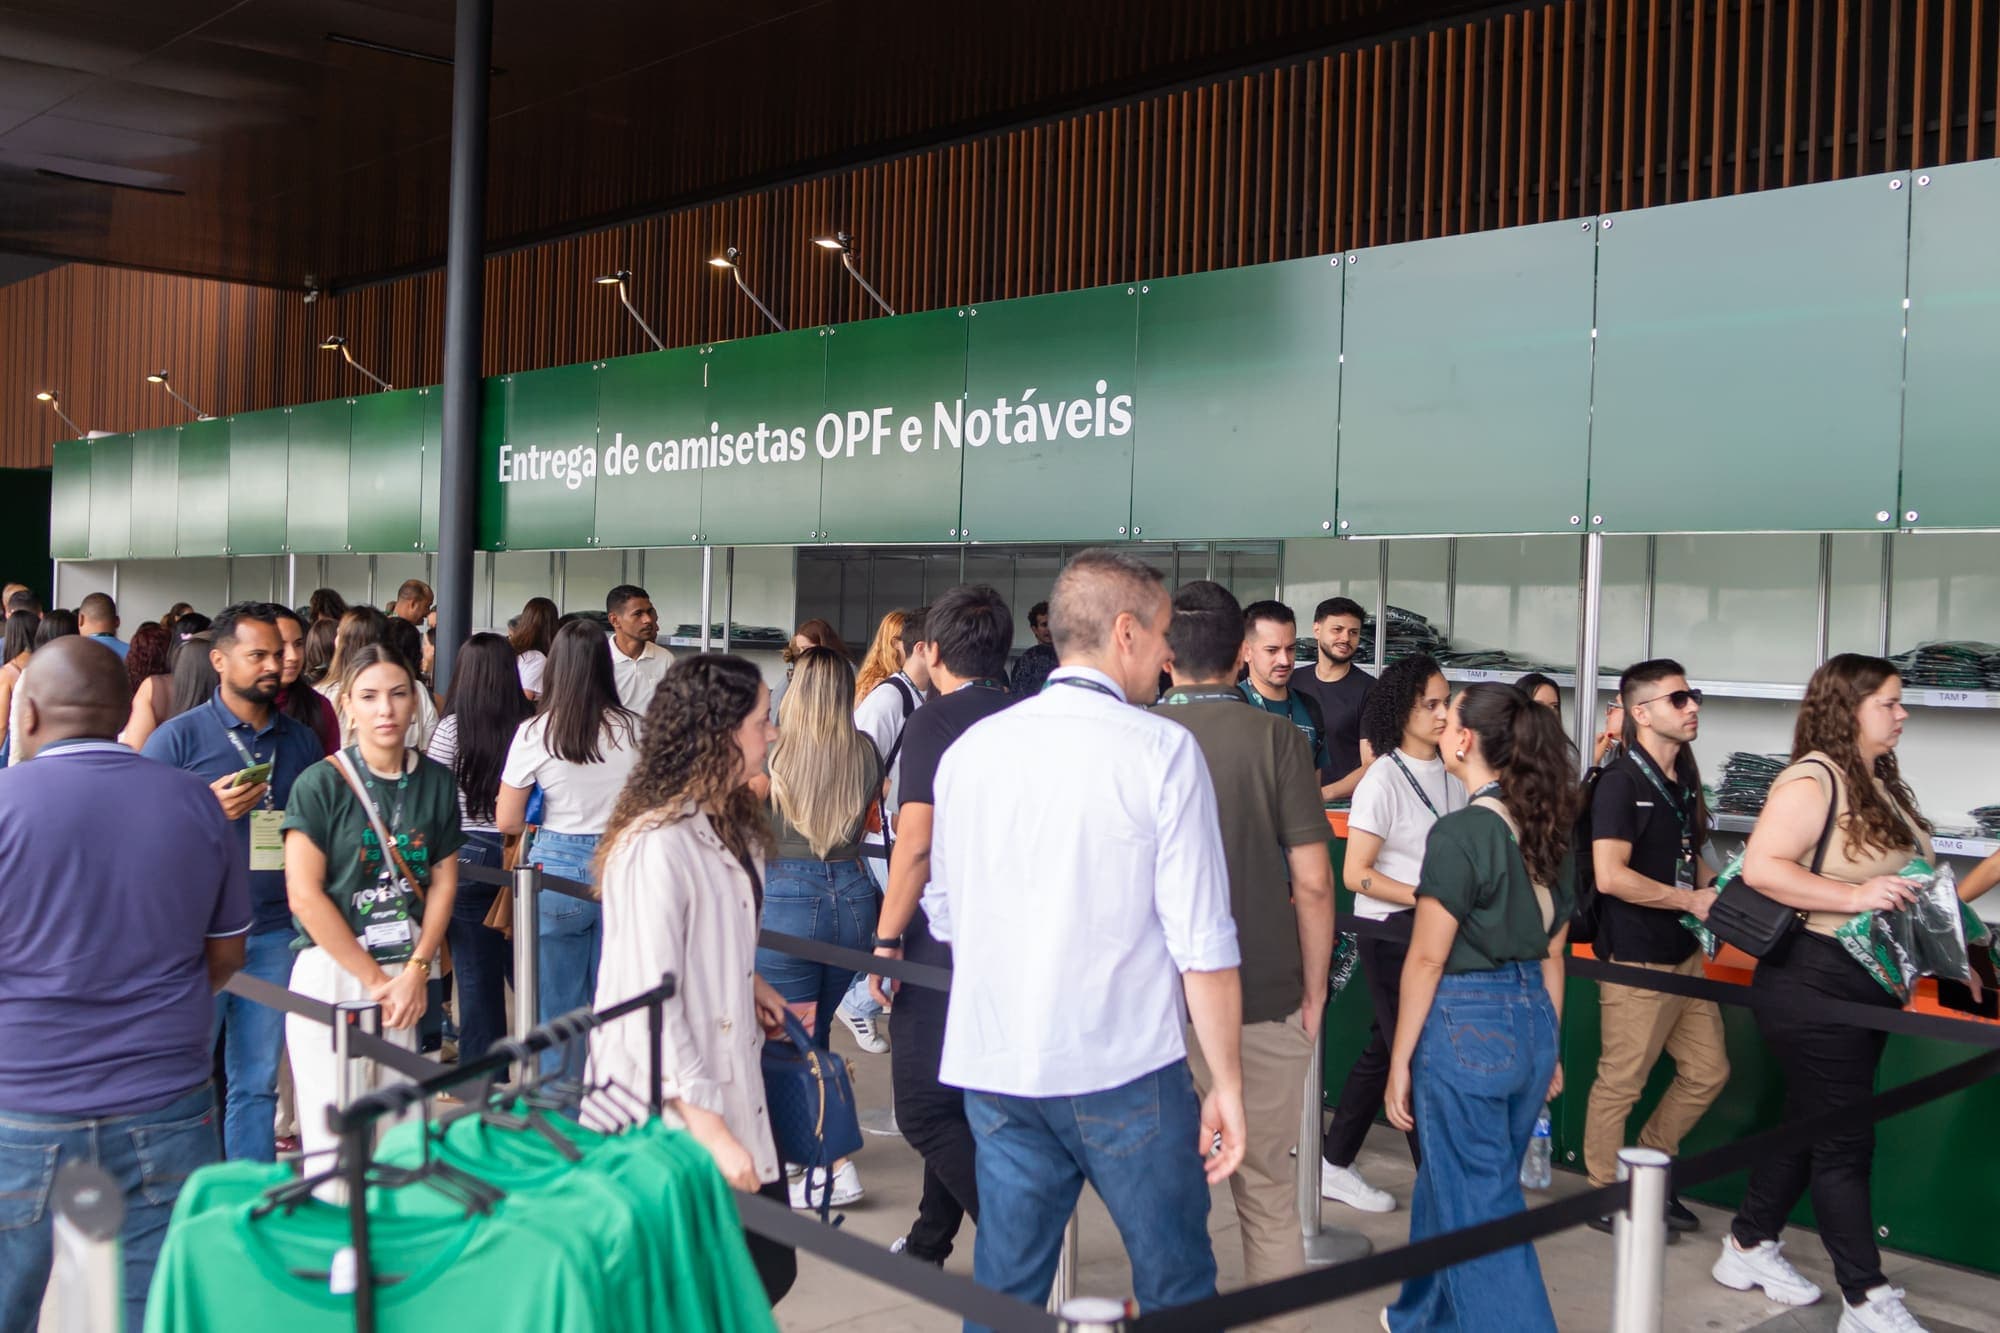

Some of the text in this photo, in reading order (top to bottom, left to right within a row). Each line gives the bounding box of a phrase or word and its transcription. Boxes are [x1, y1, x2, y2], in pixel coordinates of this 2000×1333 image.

[499, 379, 1133, 490] Entrega de camisetas OPF e Notáveis
[1467, 670, 1481, 678] TAM
[1939, 692, 1968, 701] TAM P
[1934, 839, 1963, 849] TAM G
